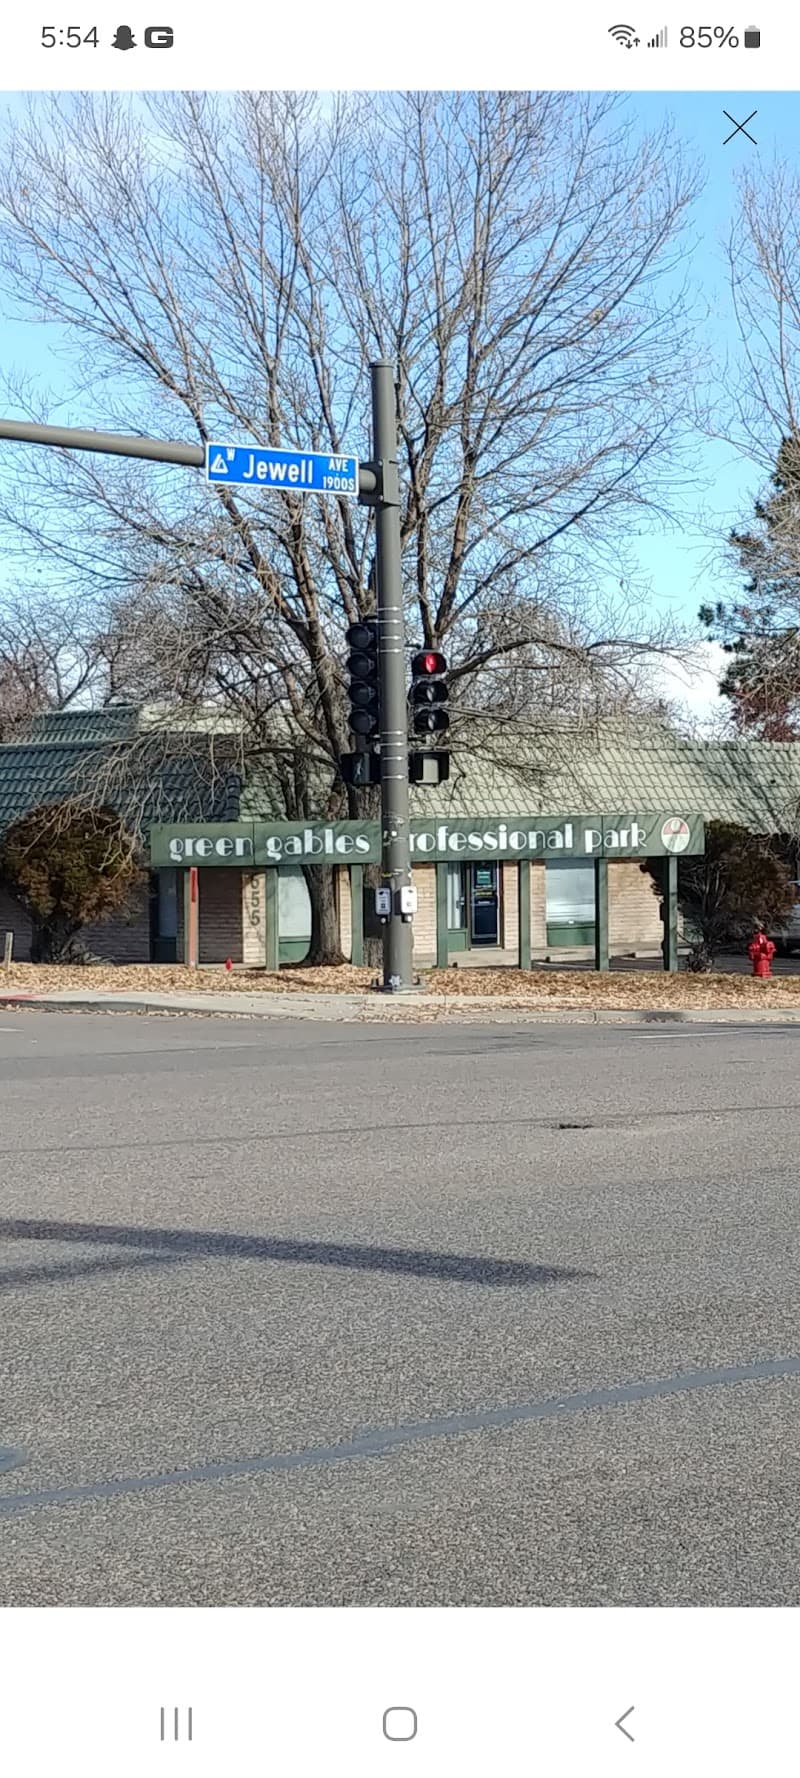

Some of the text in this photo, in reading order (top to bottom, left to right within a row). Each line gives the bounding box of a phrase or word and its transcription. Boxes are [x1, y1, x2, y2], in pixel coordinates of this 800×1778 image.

[226, 447, 313, 484] W Jewell
[328, 457, 349, 472] AVE
[322, 476, 355, 491] 1900S
[169, 822, 647, 862] green gables rofessional park
